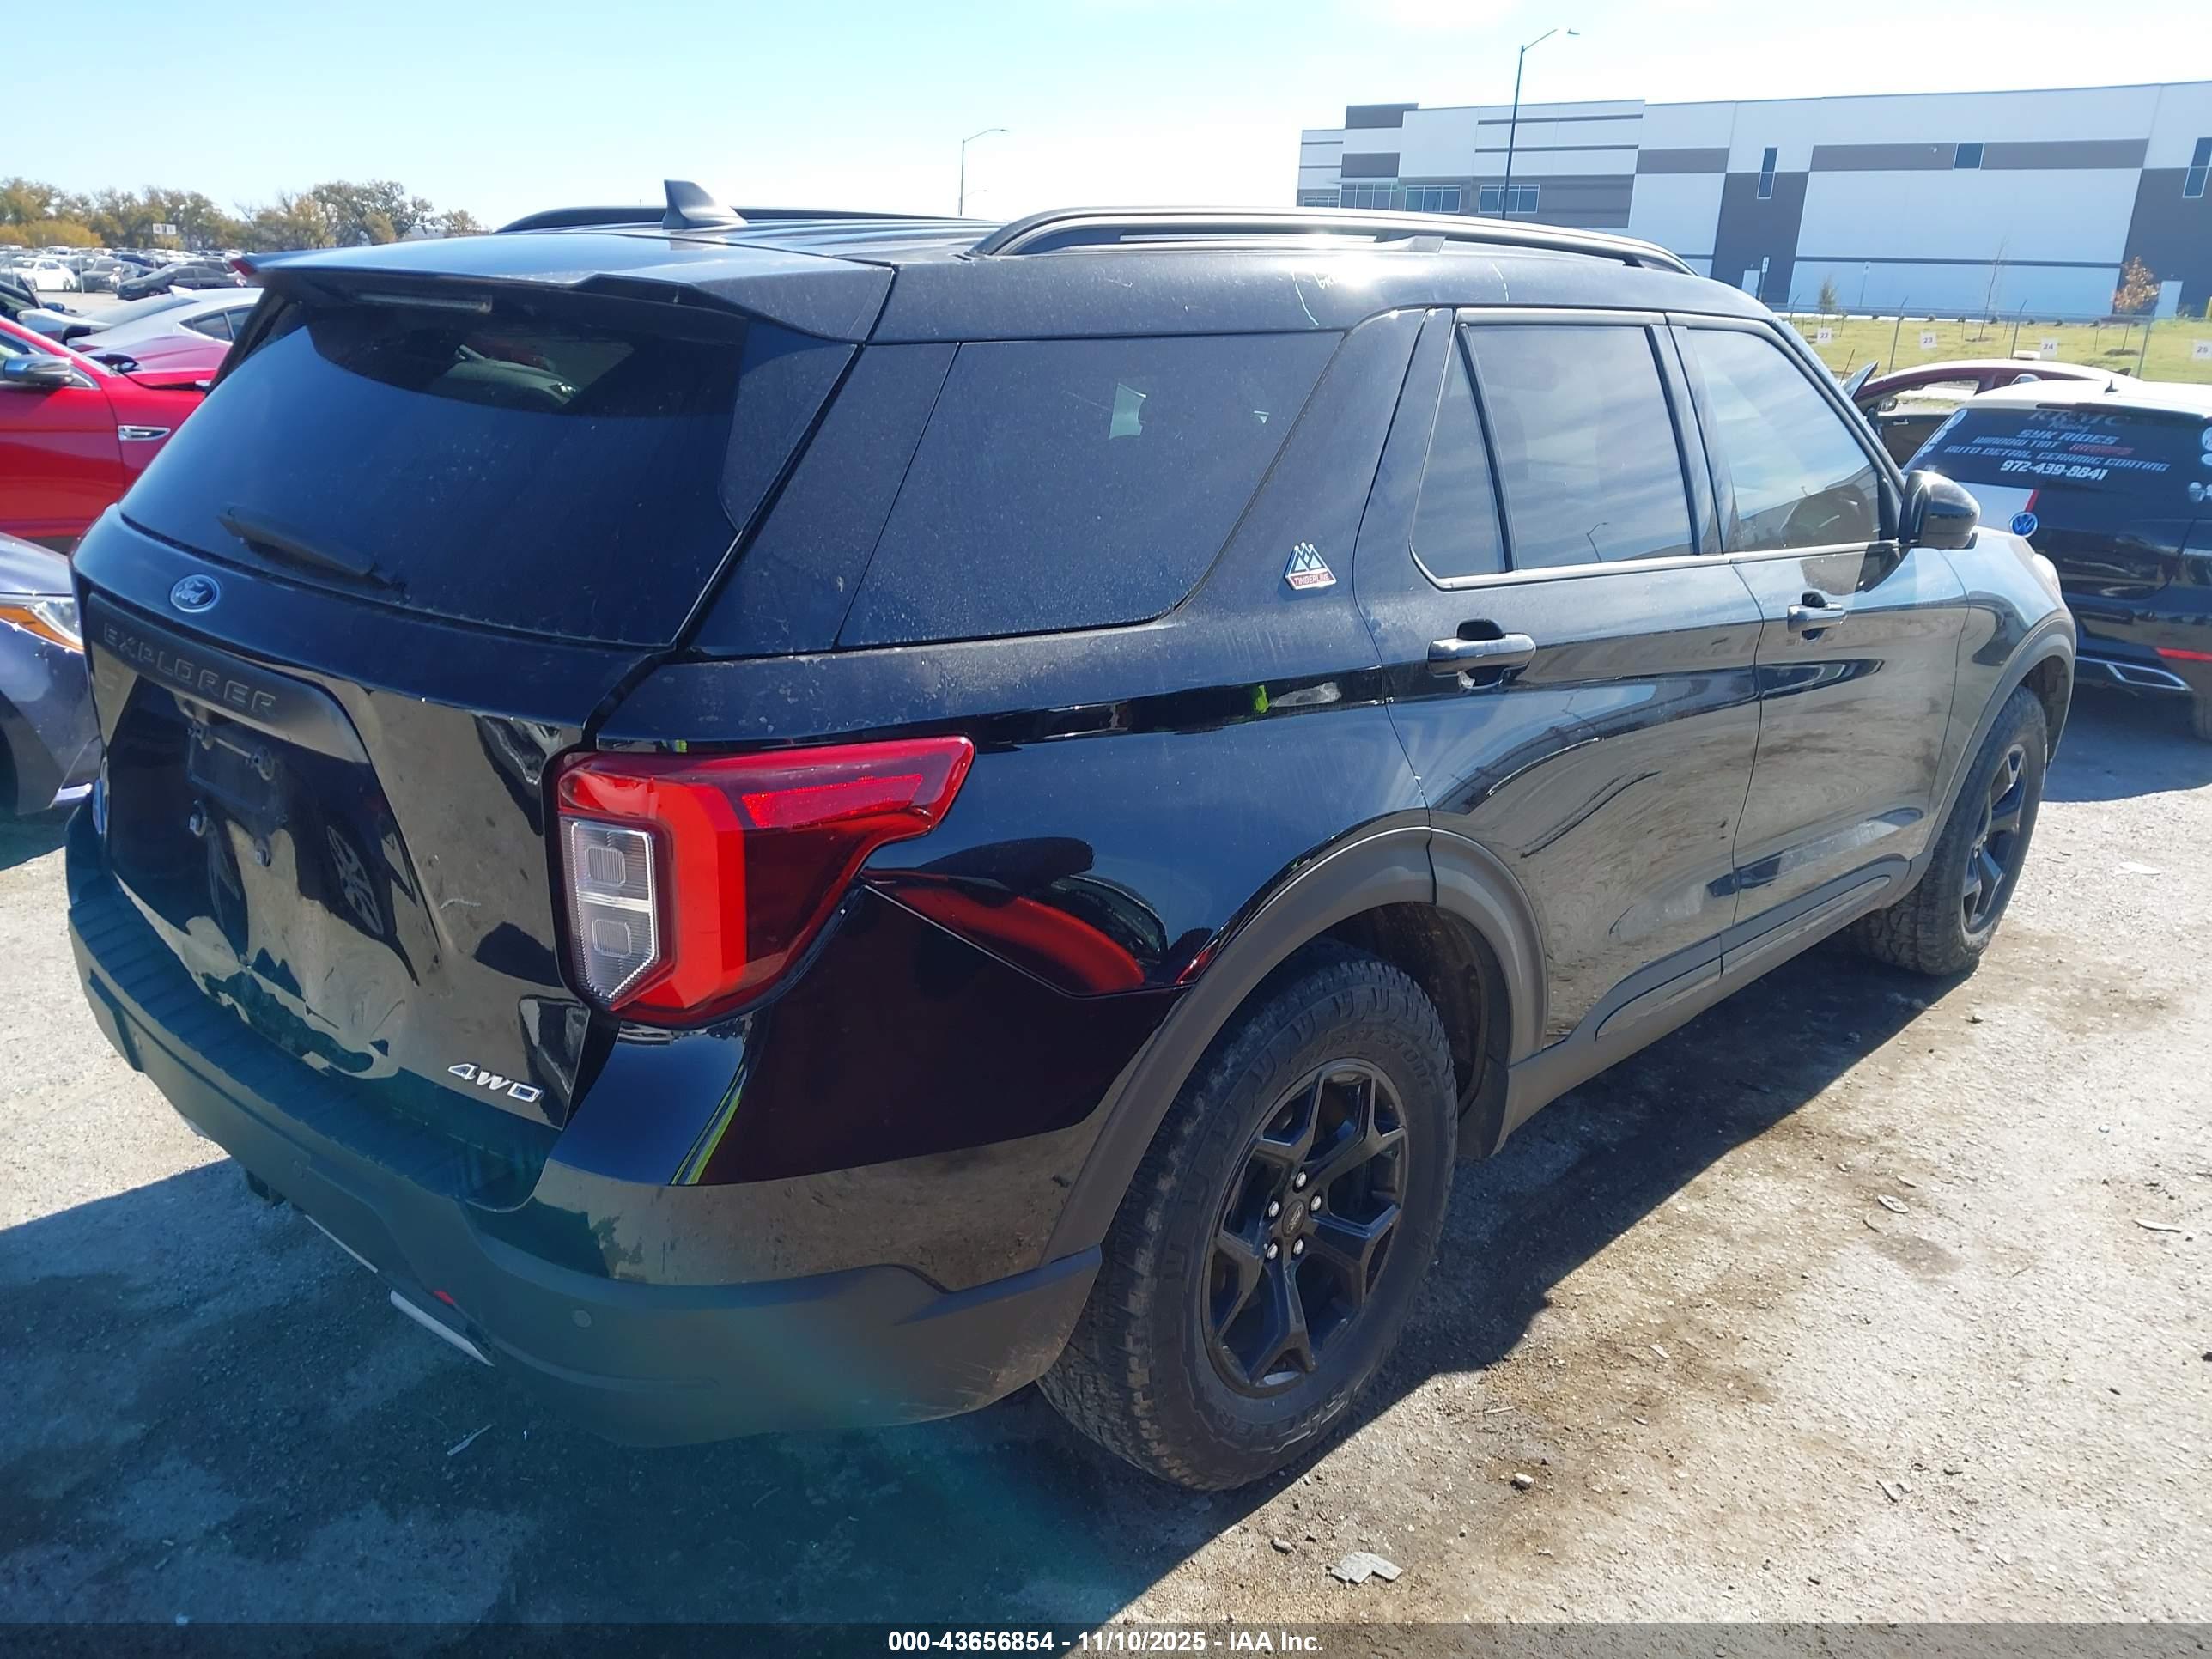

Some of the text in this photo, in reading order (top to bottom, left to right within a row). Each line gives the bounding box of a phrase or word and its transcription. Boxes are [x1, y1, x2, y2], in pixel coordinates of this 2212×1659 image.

[1944, 445, 1982, 455] AUTO
[2000, 459, 2109, 481] 972-439-8841
[103, 623, 276, 714] EXPLORER
[447, 1064, 539, 1102] 4WD
